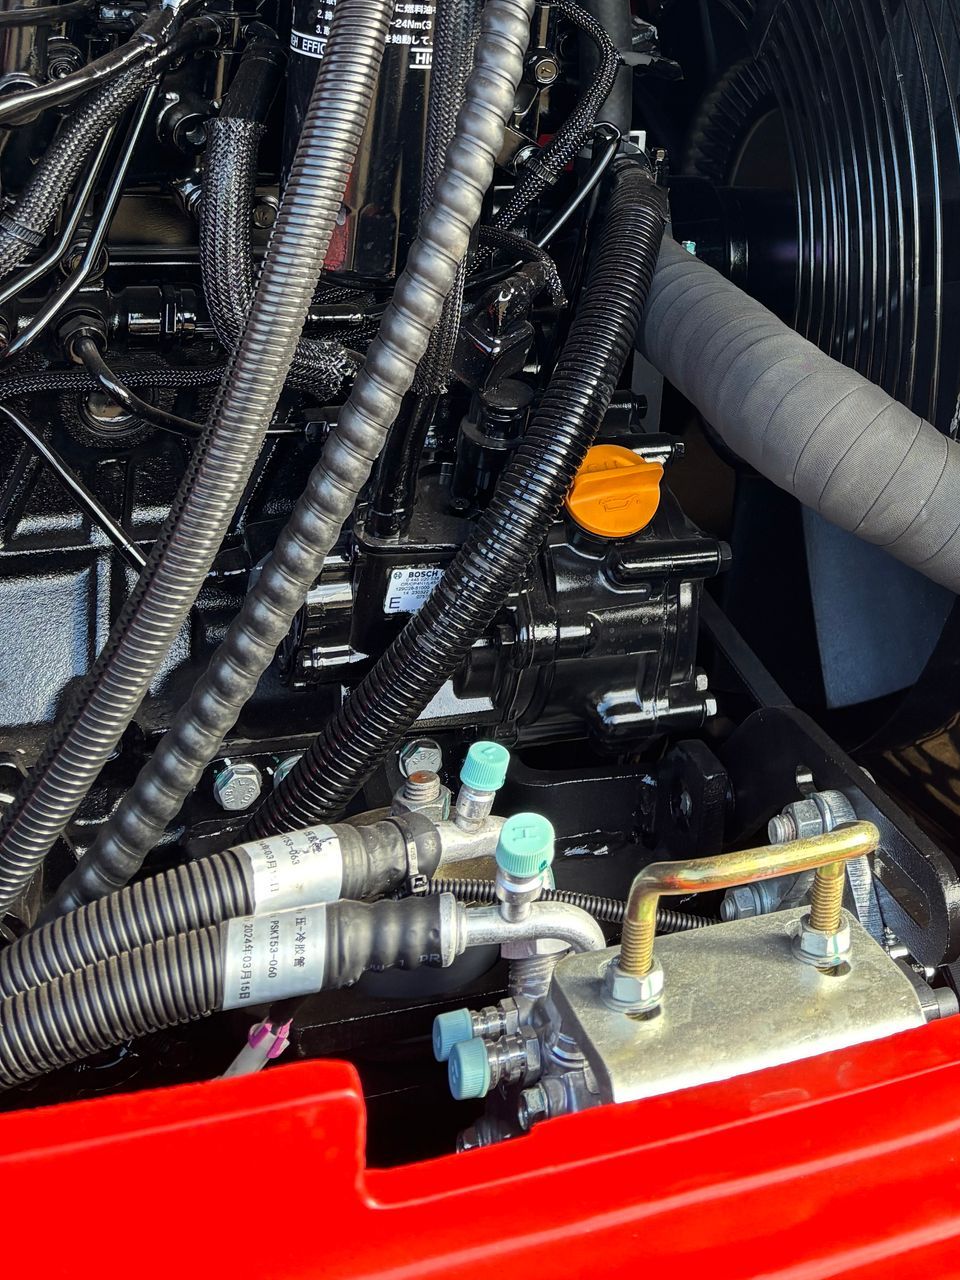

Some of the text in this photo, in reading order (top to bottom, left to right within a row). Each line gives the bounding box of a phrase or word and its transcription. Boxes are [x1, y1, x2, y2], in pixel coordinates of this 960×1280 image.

[408, 570, 439, 578] BOSCH
[389, 596, 401, 609] E
[239, 923, 254, 1000] 2024年03月15日
[267, 919, 281, 979] PSKT53-060
